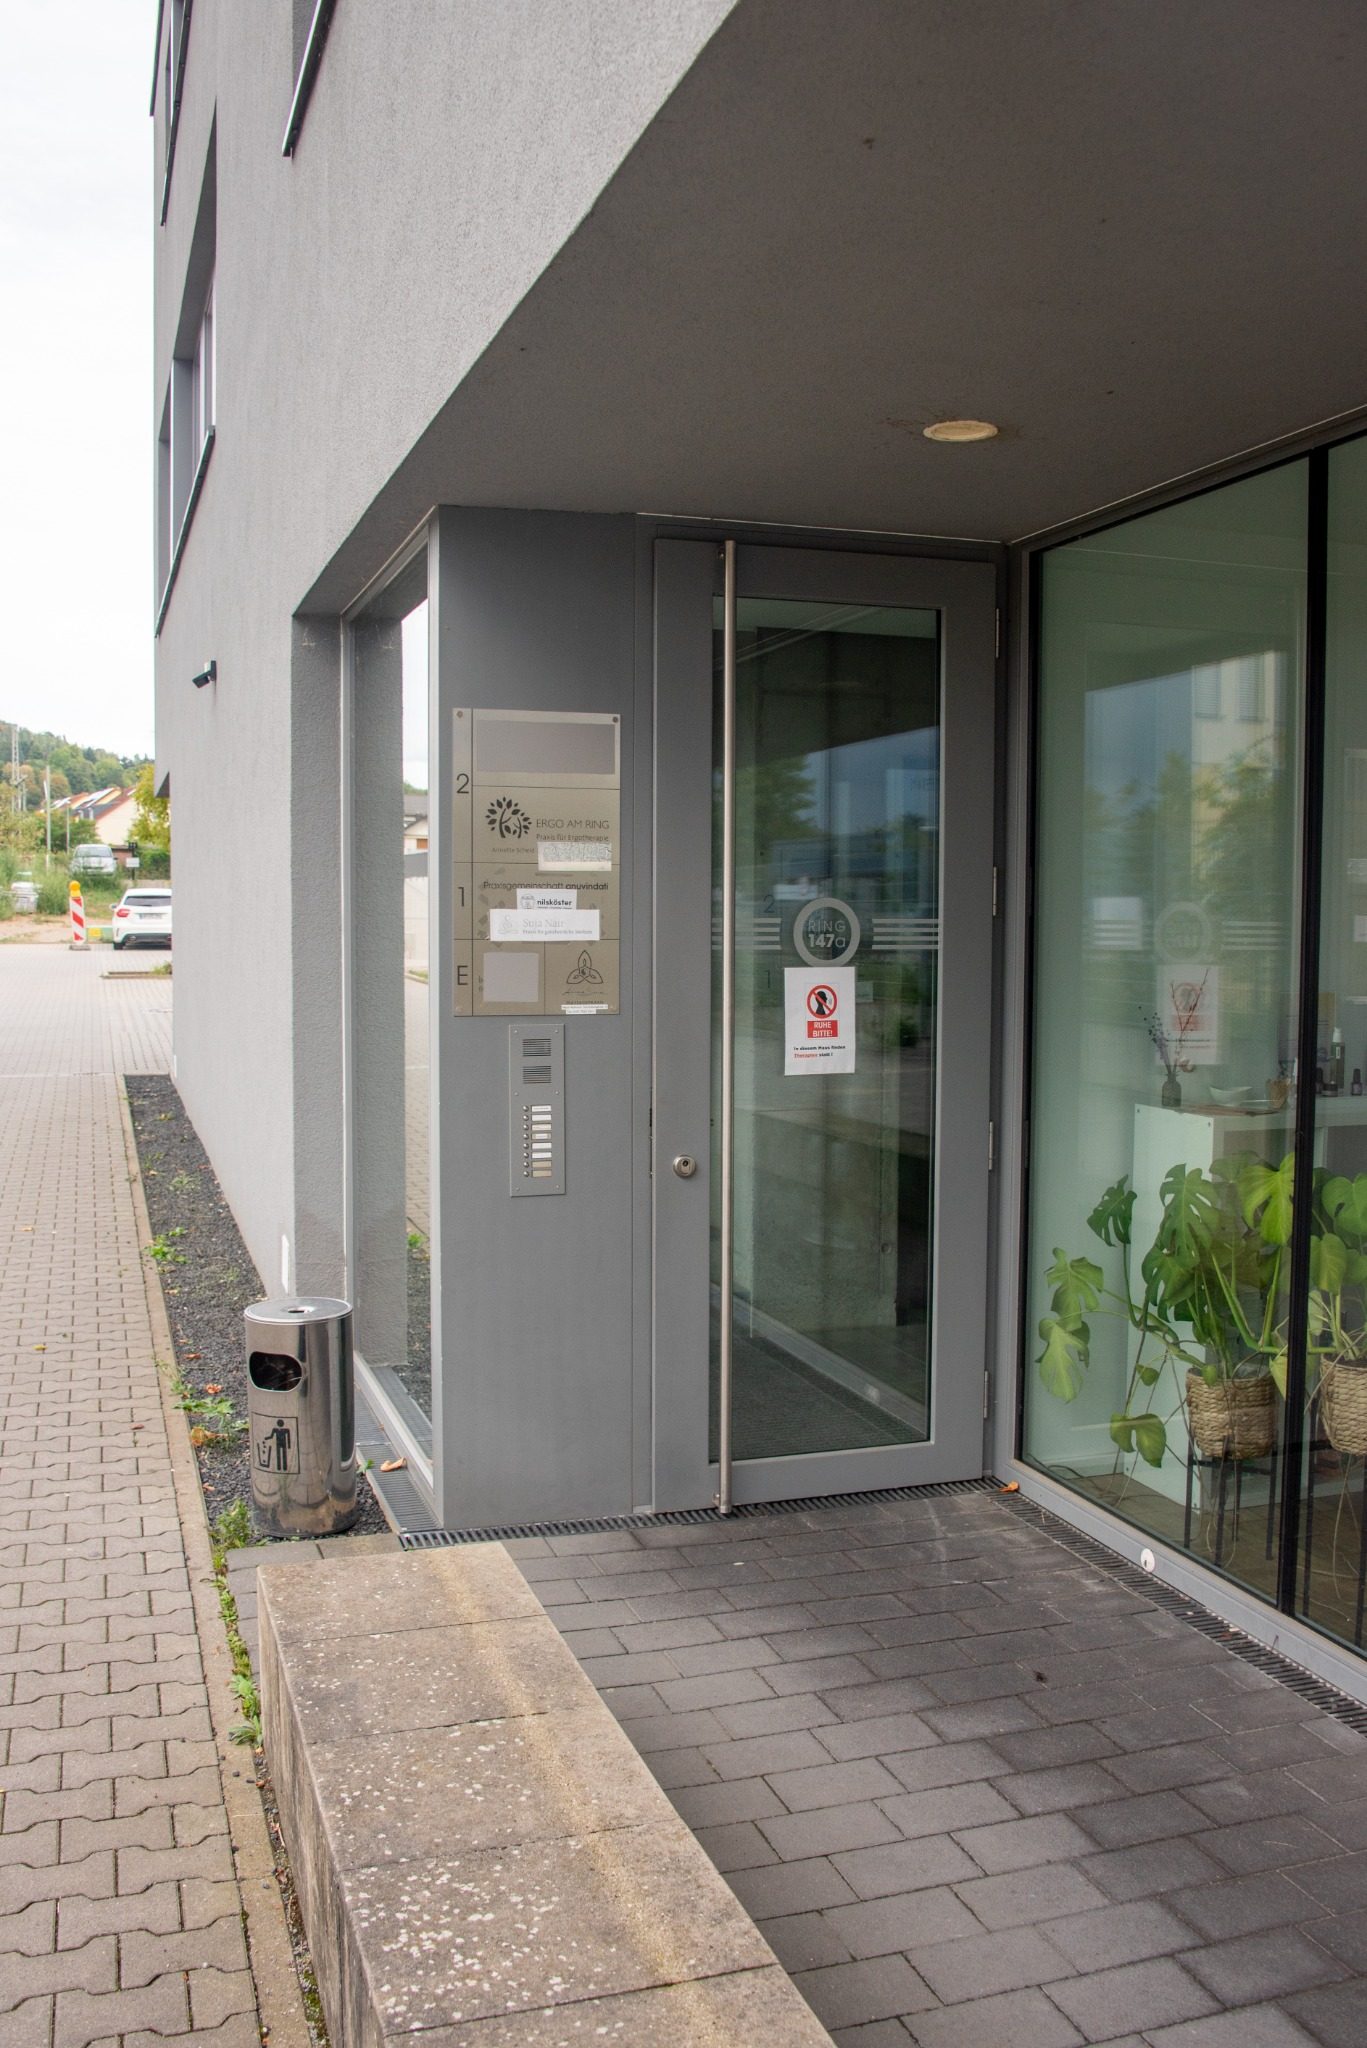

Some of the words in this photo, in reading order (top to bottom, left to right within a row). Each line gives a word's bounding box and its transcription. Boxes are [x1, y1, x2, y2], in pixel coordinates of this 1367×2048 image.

[456, 773, 470, 794] 2
[536, 818, 564, 829] ERGO
[567, 819, 583, 829] AM
[585, 819, 610, 830] RING
[536, 833, 555, 841] Praxis
[556, 833, 566, 841] für
[483, 881, 563, 890] Praxisgemeinschaft
[565, 882, 609, 890] anuvindati
[457, 886, 465, 907] 1
[537, 898, 572, 906] nilsköster
[808, 919, 846, 932] RING
[808, 933, 846, 948] 147a
[456, 965, 469, 986] E
[813, 1021, 832, 1029] RUHE
